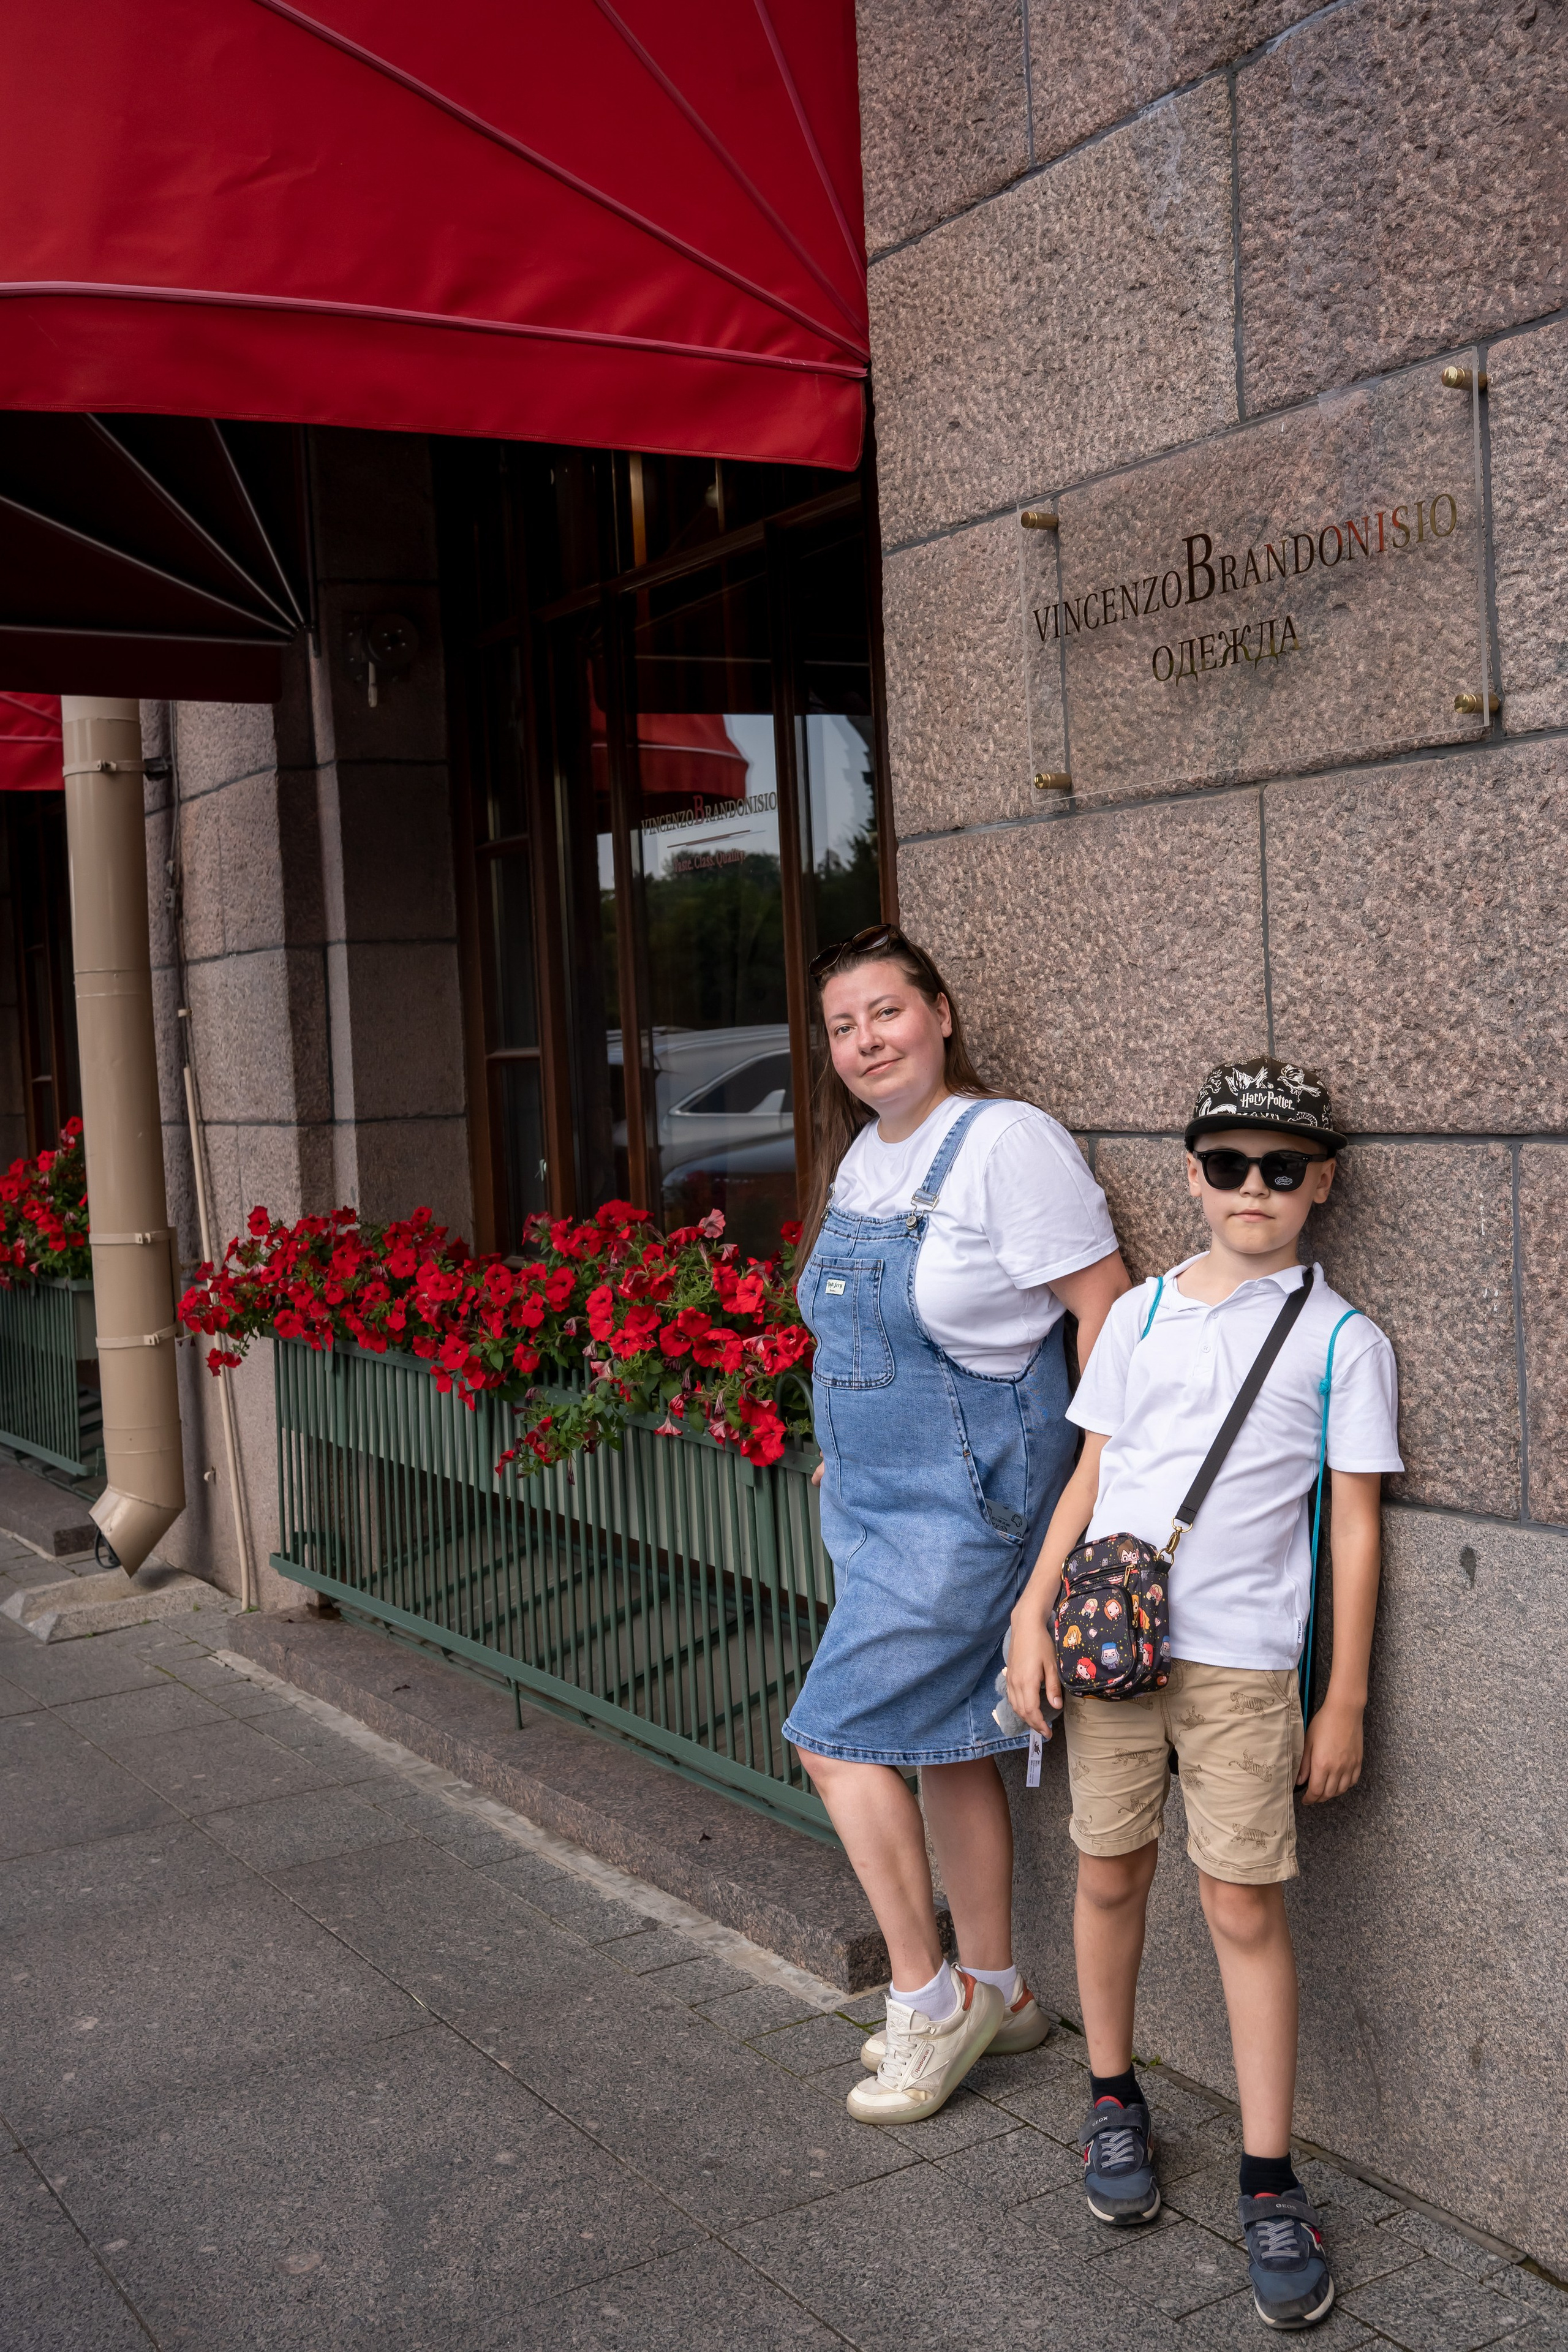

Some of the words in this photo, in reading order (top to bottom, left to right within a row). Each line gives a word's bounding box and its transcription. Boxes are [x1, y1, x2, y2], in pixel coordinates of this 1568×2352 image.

[1152, 614, 1302, 686] ОДЕЖДА
[1240, 1092, 1267, 1108] Harry
[1267, 1091, 1293, 1110] Potter
[915, 2055, 927, 2073] Reebok
